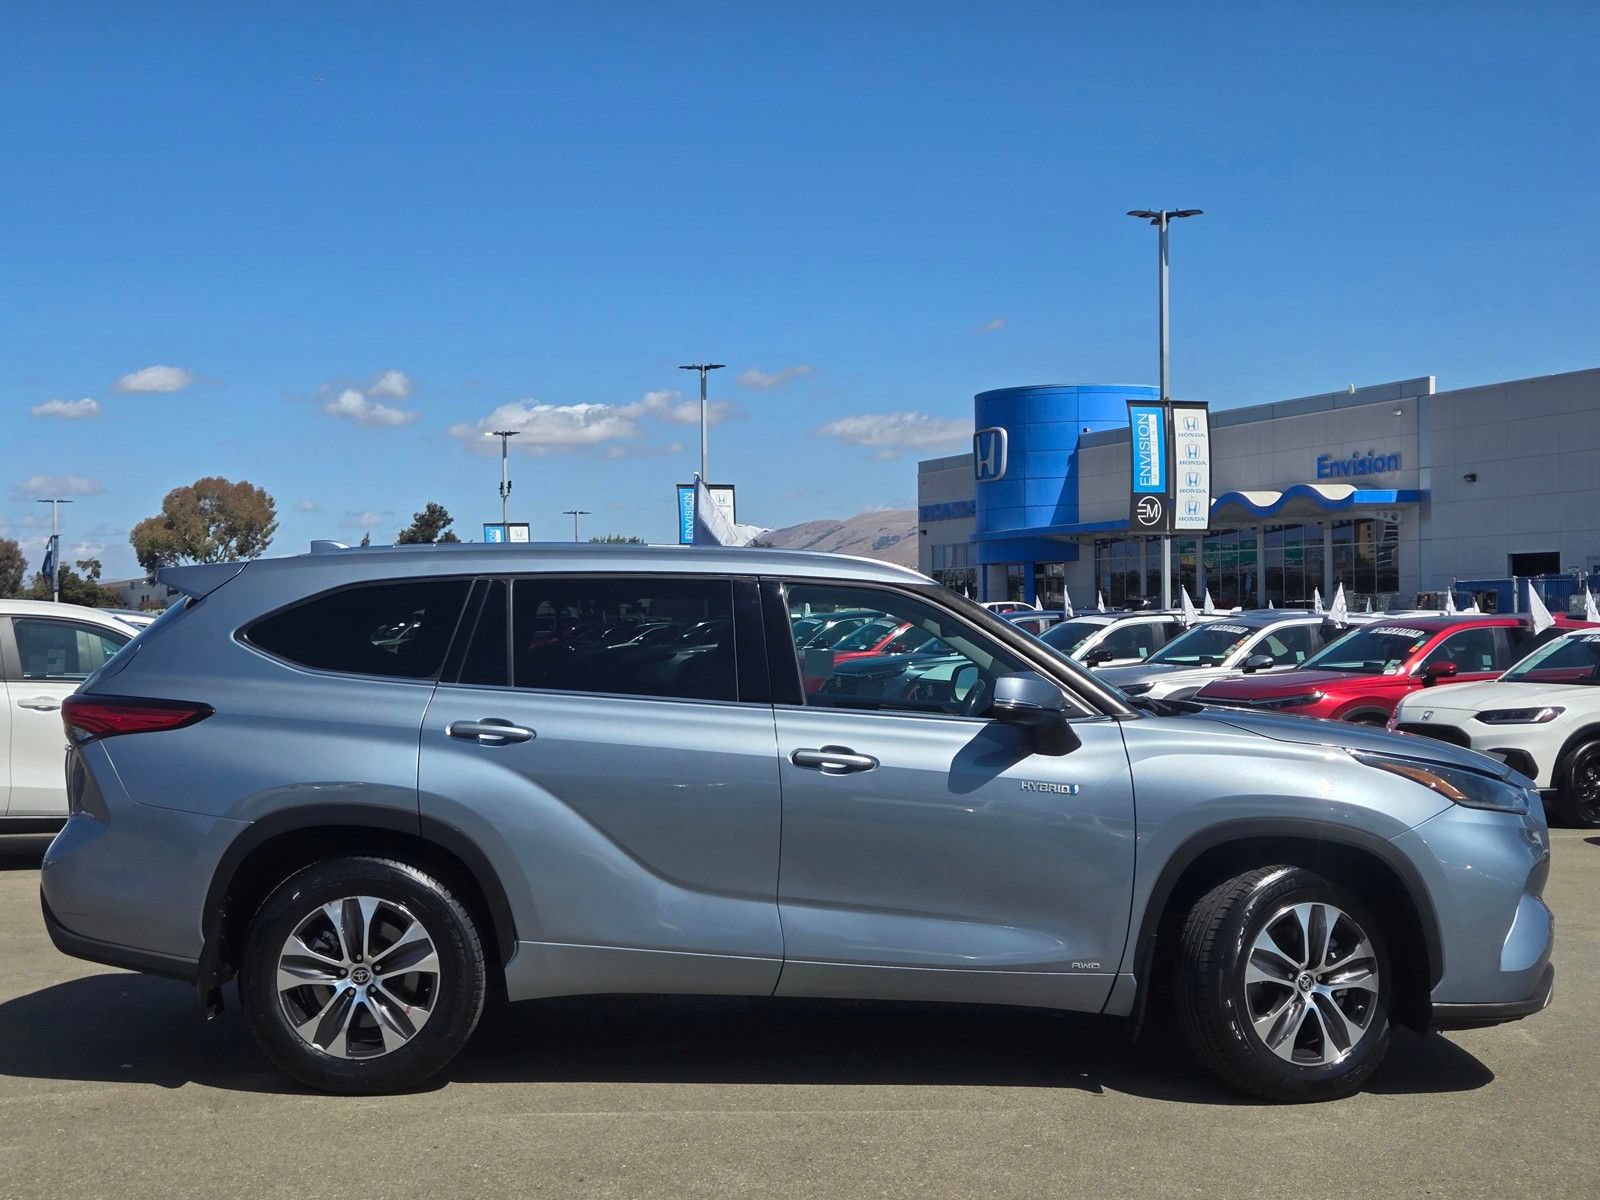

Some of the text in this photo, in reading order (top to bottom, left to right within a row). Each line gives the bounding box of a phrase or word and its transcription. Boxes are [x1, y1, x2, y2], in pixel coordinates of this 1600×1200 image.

[1137, 413, 1151, 486] ENVISION
[1316, 450, 1402, 479] Envision
[684, 492, 694, 540] ENVISION
[1021, 781, 1071, 794] HYBRID
